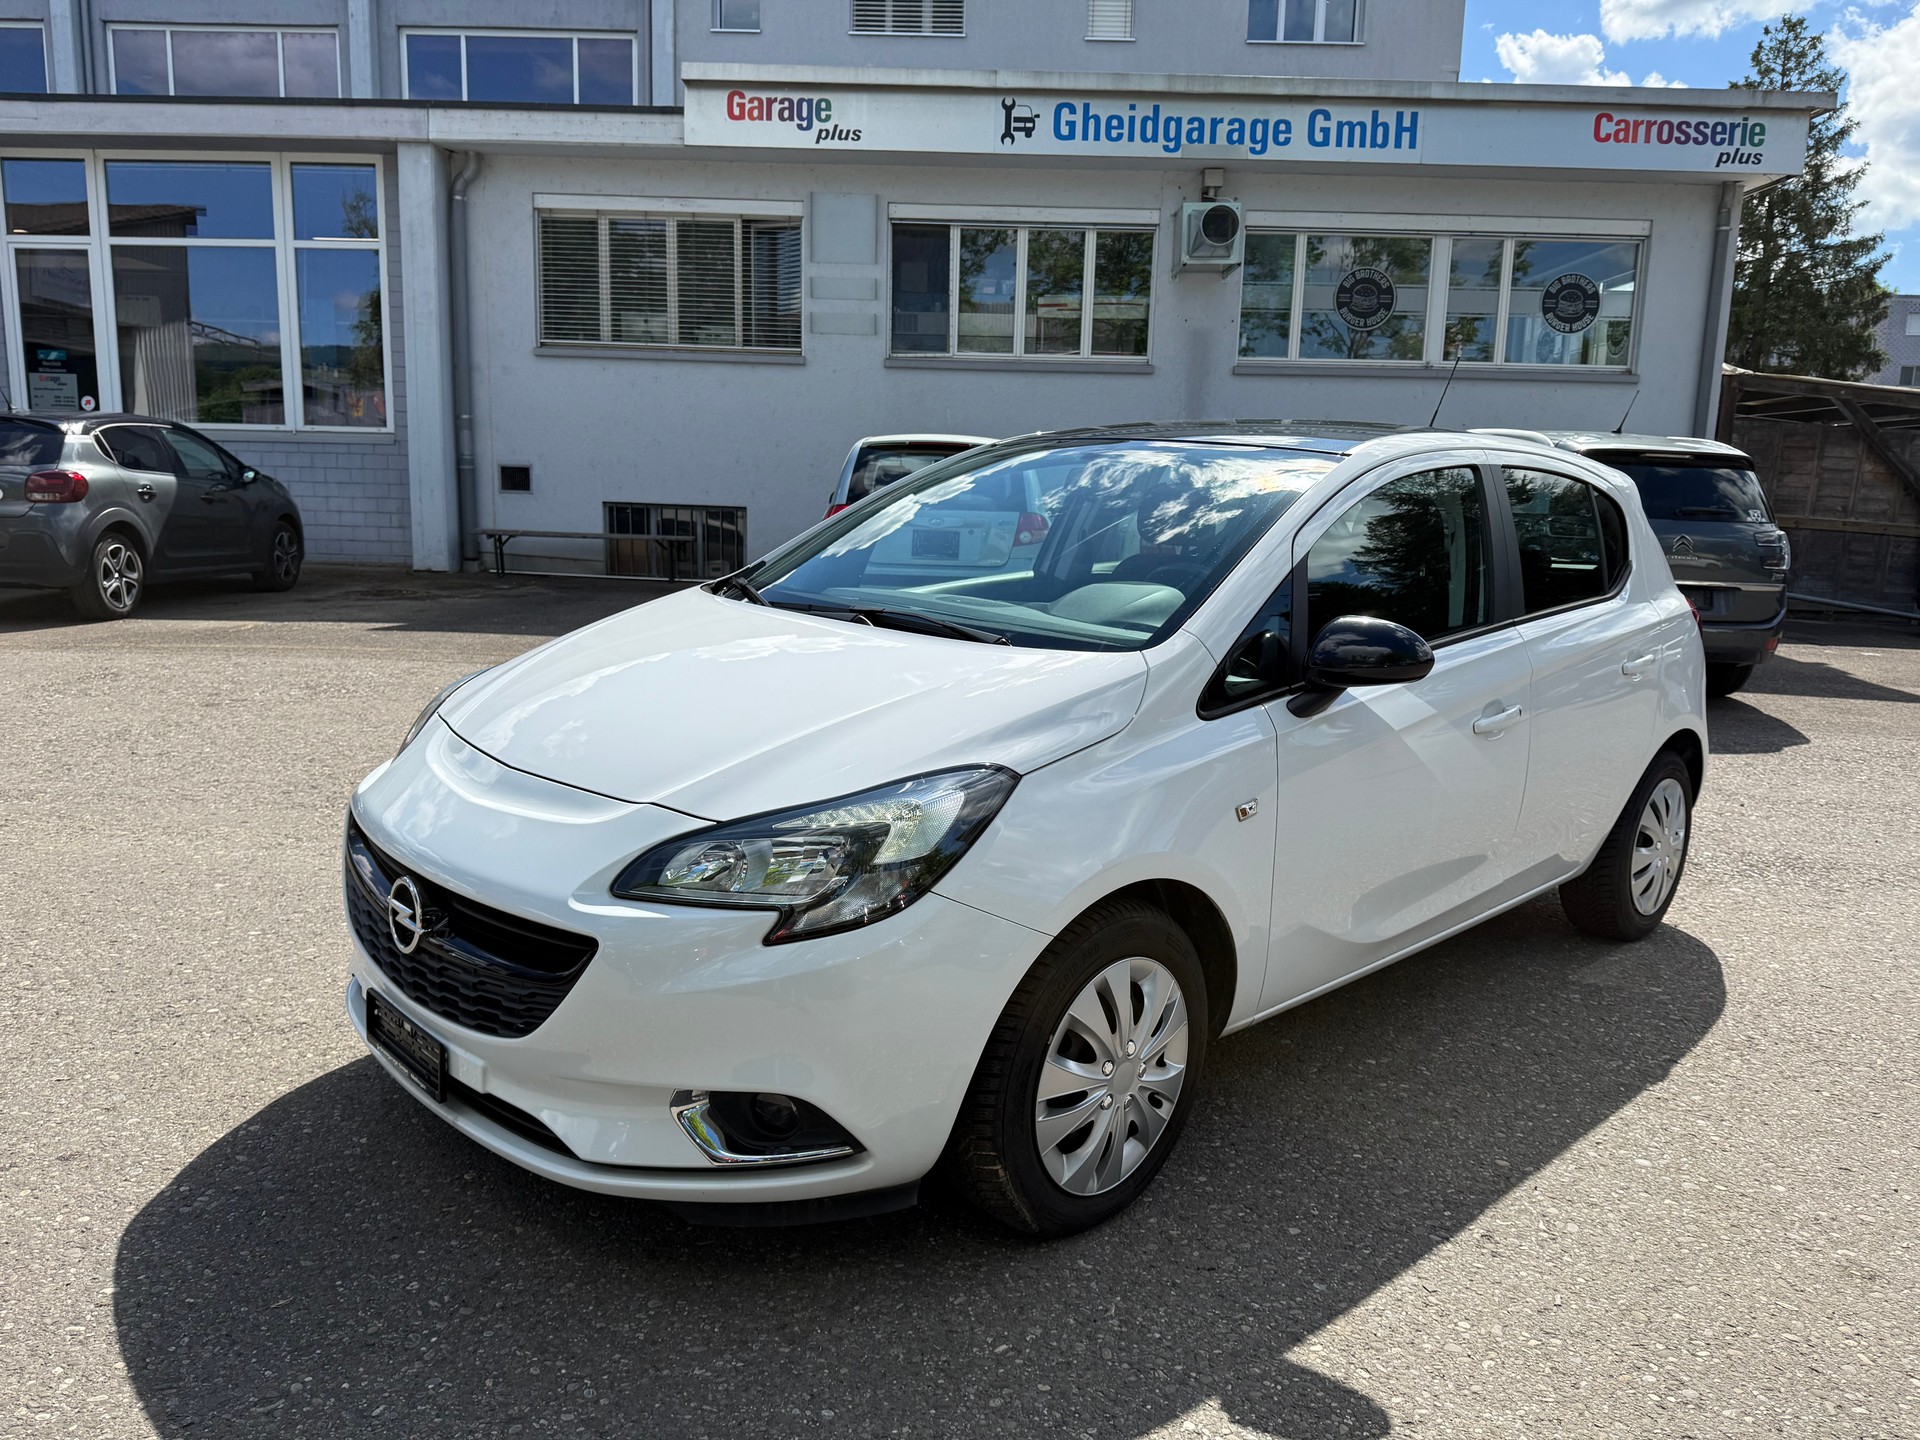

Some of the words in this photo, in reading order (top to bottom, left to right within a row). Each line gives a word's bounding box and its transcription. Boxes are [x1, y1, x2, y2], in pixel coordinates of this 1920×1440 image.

[726, 90, 832, 132] Garage
[815, 123, 863, 145] plus
[1053, 101, 1292, 155] Gheidgarage
[1307, 108, 1419, 149] GmbH
[1593, 112, 1767, 147] Carrosserie
[1715, 147, 1764, 168] plus
[1342, 274, 1356, 289] BIG
[1354, 269, 1391, 289] BROTHERS
[1548, 279, 1562, 294] BIG
[1561, 274, 1597, 295] BROTHERS
[1339, 306, 1365, 327] BURGER
[1366, 307, 1389, 327] HOUSE
[1545, 312, 1571, 332] BURGER
[1571, 312, 1595, 332] HOUSE
